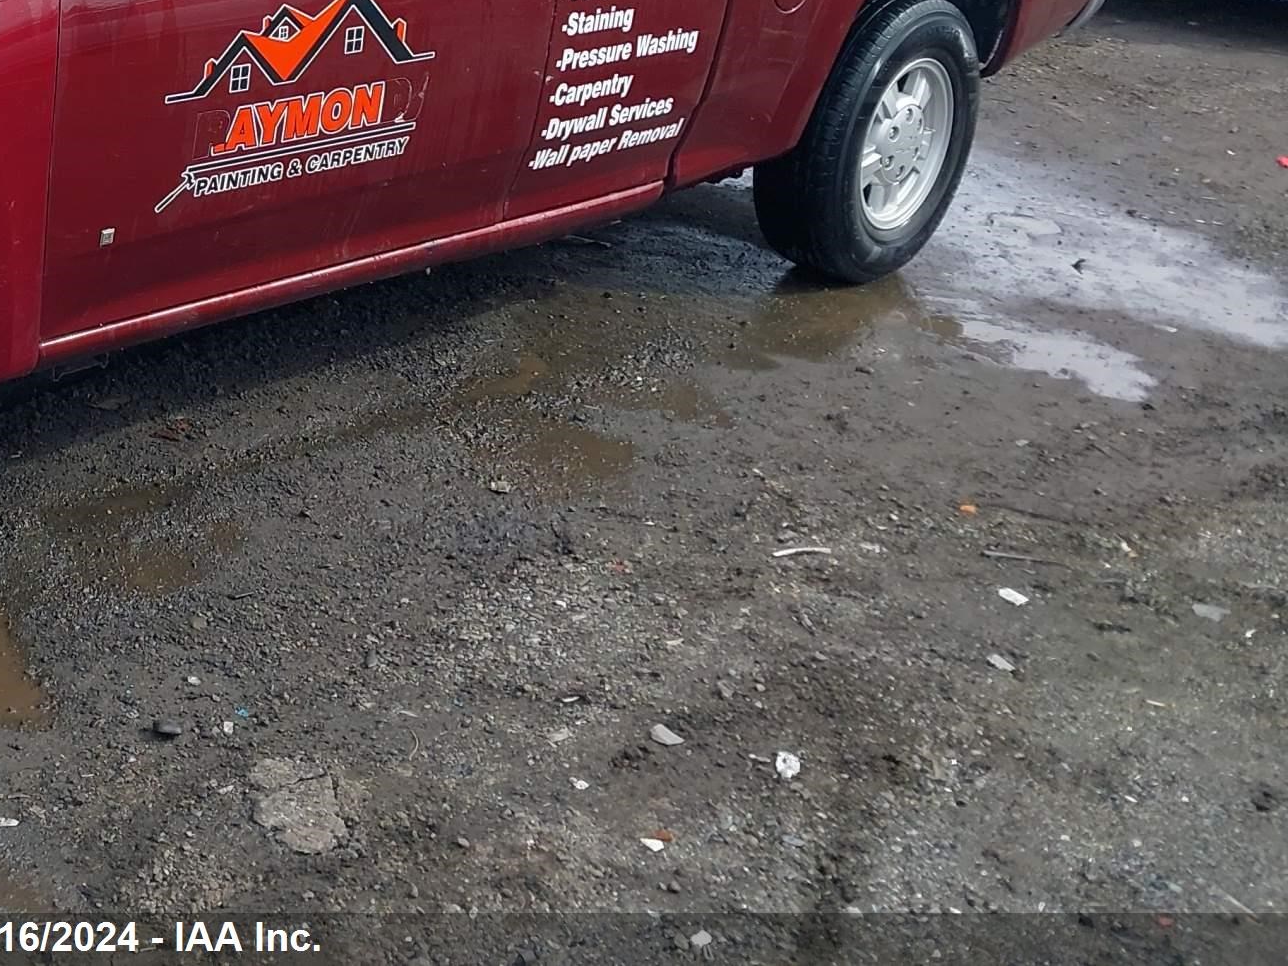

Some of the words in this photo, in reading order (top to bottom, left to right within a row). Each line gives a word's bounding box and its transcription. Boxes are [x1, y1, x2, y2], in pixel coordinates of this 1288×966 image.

[562, 6, 634, 36] -Staining
[556, 41, 632, 71] -Pressure
[636, 28, 700, 58] Washing
[549, 74, 634, 107] -Carpentry
[541, 107, 608, 141] -Drywall
[609, 97, 674, 127] Services
[528, 144, 570, 170] -Wall
[566, 136, 617, 166] paper
[616, 118, 686, 151] Removal
[194, 163, 284, 197] PAINTING
[286, 158, 302, 178] &
[305, 136, 410, 173] CARPENTRY
